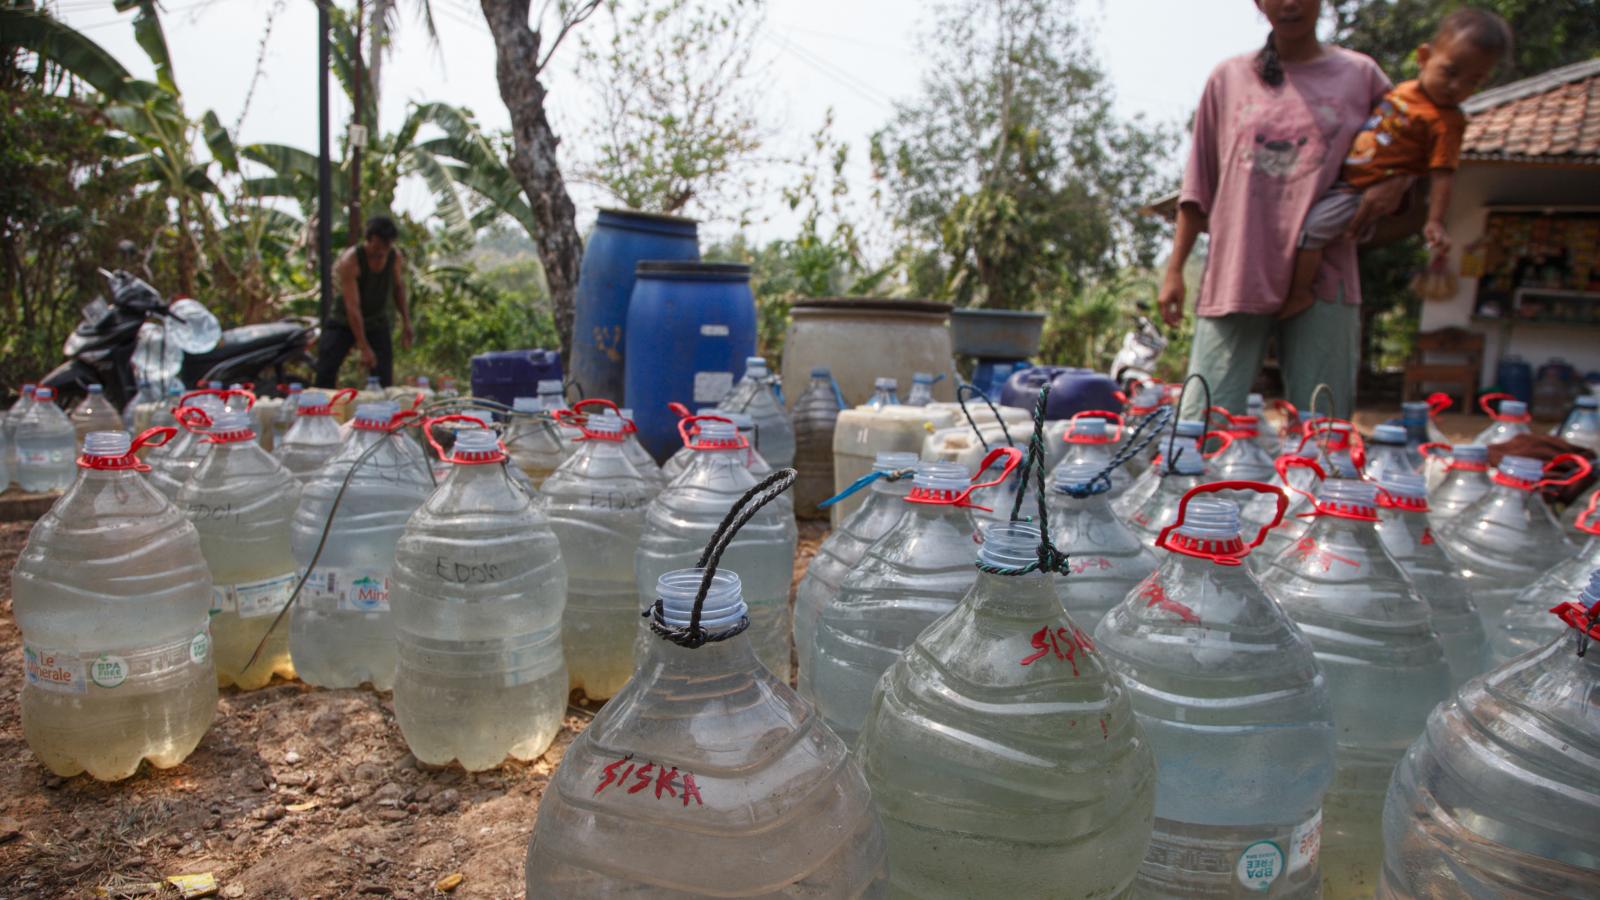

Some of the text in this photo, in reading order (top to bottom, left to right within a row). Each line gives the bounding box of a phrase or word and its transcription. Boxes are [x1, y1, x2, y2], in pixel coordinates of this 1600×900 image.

[40, 650, 55, 668] Le
[592, 753, 704, 809] SISKA
[1247, 859, 1273, 869] FREE
[1247, 867, 1273, 879] BPA
